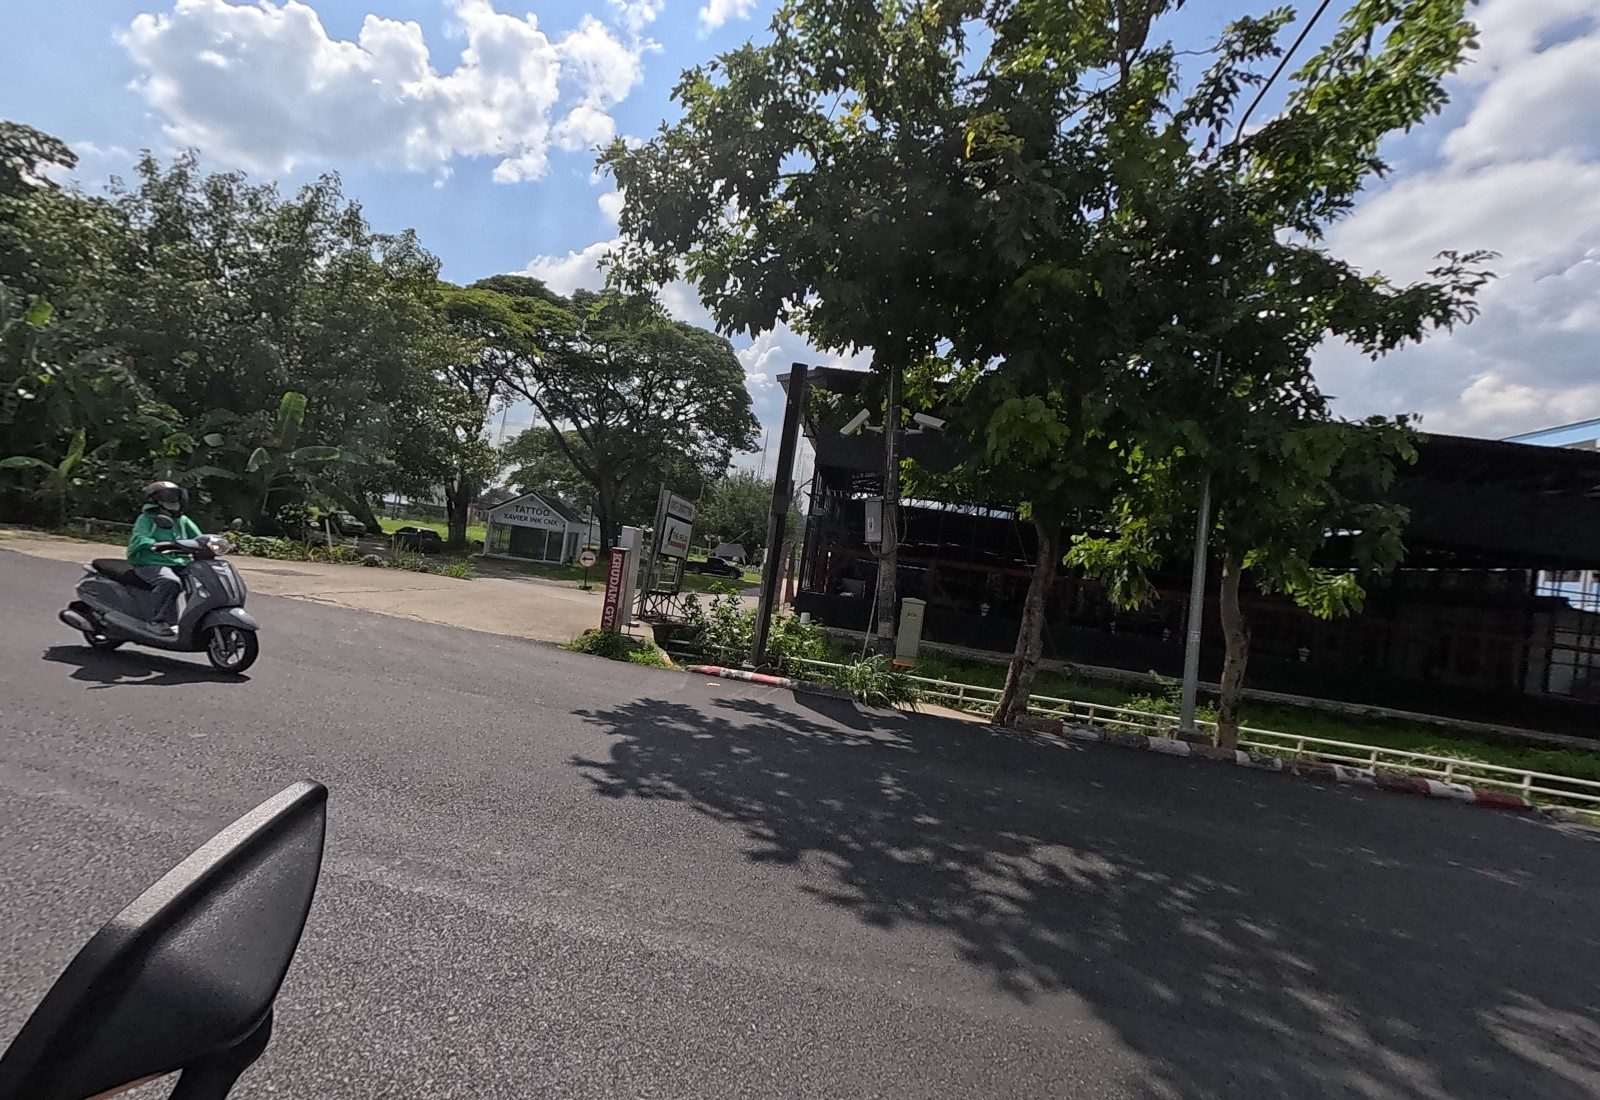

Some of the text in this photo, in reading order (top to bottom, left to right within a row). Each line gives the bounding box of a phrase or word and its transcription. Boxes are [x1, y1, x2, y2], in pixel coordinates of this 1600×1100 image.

[515, 505, 550, 516] TATTOO
[503, 513, 528, 521] XAVIER
[544, 518, 558, 526] CNX
[606, 553, 622, 604] KRUDAM
